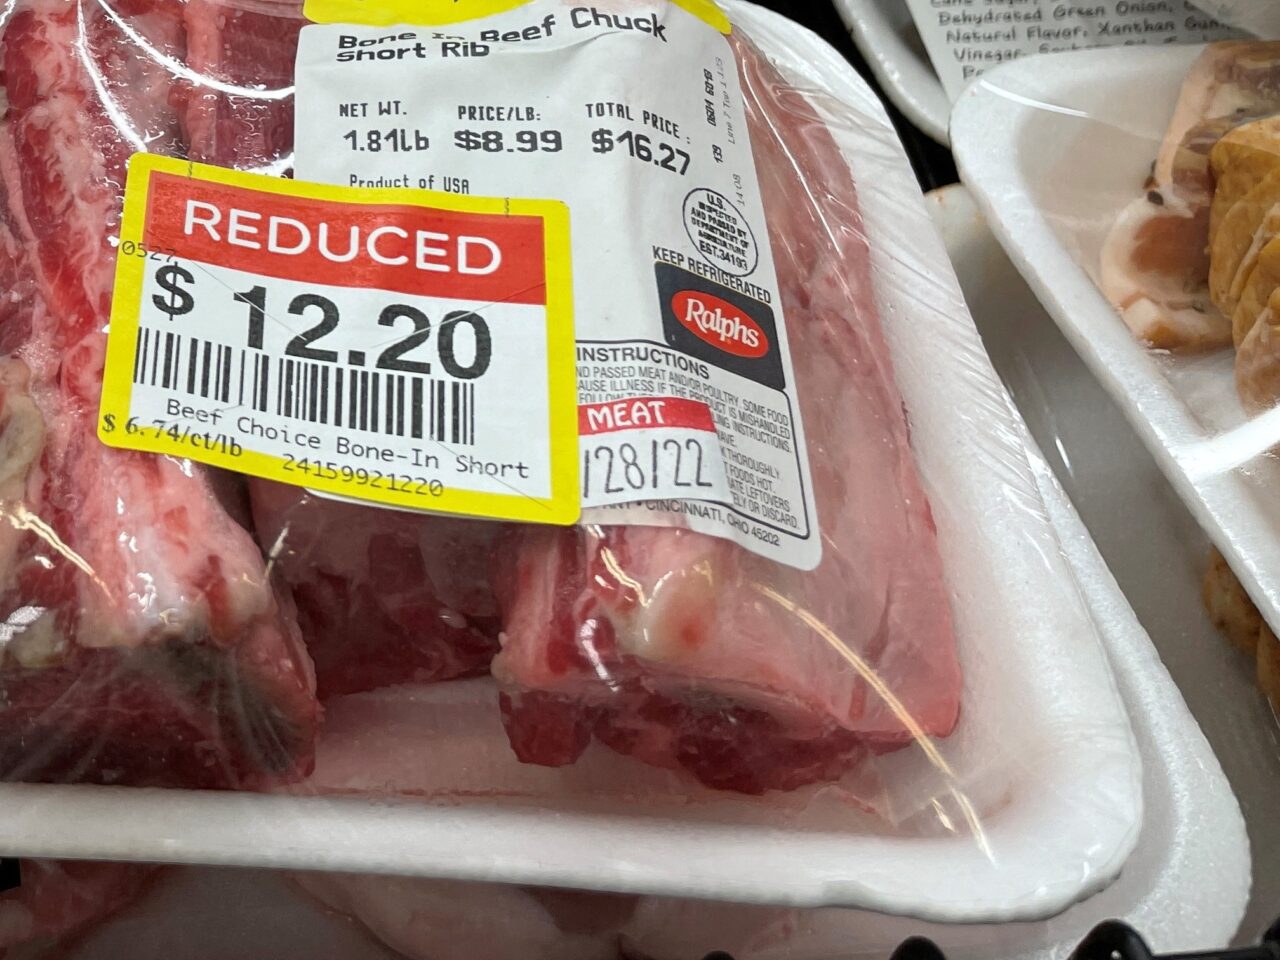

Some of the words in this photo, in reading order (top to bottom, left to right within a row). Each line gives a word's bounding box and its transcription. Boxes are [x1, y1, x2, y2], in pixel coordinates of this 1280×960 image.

[338, 31, 417, 50] Bone
[480, 14, 556, 43] Beef
[570, 6, 668, 43] Chuck
[938, 8, 1042, 28] Dehydrated
[1053, 4, 1105, 21] Green
[1115, 0, 1173, 16] Onion,
[945, 26, 1017, 44] Natural
[1027, 25, 1087, 41] Flavor,
[1098, 16, 1175, 35] Xanthan
[336, 42, 427, 63] Short
[441, 41, 491, 59] Rib
[339, 103, 368, 117] NET
[378, 100, 408, 116] WT.
[458, 105, 542, 121] PRICE/LB:
[586, 102, 634, 121] TOTAL
[642, 109, 681, 139] PRICE
[343, 128, 430, 153] 1.81lb
[454, 129, 564, 153] $8.99
[591, 127, 691, 176] $16.27
[349, 173, 410, 189] Product
[418, 174, 435, 190] of
[443, 176, 470, 195] USA
[691, 207, 707, 221] AND
[706, 193, 727, 211] U.S.
[122, 240, 177, 263] 0527
[184, 199, 502, 275] REDUCED
[652, 245, 685, 267] KEEP
[687, 257, 772, 305] REFRIGERATED
[152, 262, 195, 321] $
[233, 285, 493, 380] 12.20
[685, 298, 759, 348] Ralphs
[577, 346, 710, 381] INSTRUCTIONS
[593, 365, 635, 379] PASSED
[638, 366, 667, 381] MEAT
[669, 370, 702, 391] AND/OR
[742, 398, 767, 419] SOME
[768, 410, 789, 427] FOOD
[609, 379, 650, 393] ILLNESS
[657, 381, 667, 394] IF
[669, 383, 687, 399] THE
[728, 405, 738, 420] IS
[738, 410, 791, 440] MISHANDLED
[102, 413, 117, 434] $
[587, 401, 666, 431] MEAT
[167, 398, 223, 426] Beef
[237, 416, 321, 450] Choice
[336, 436, 440, 470] Bone-In
[455, 455, 530, 480] Short
[732, 420, 792, 454] INSTRUCTIONS.
[282, 453, 445, 498] 24159921220
[730, 464, 757, 486] FOODS
[746, 485, 791, 512] LEFTOVERS
[748, 500, 762, 515] OR
[646, 499, 727, 525] CINCINNATI,
[727, 512, 750, 535] OHIO
[751, 527, 781, 547] 45202
